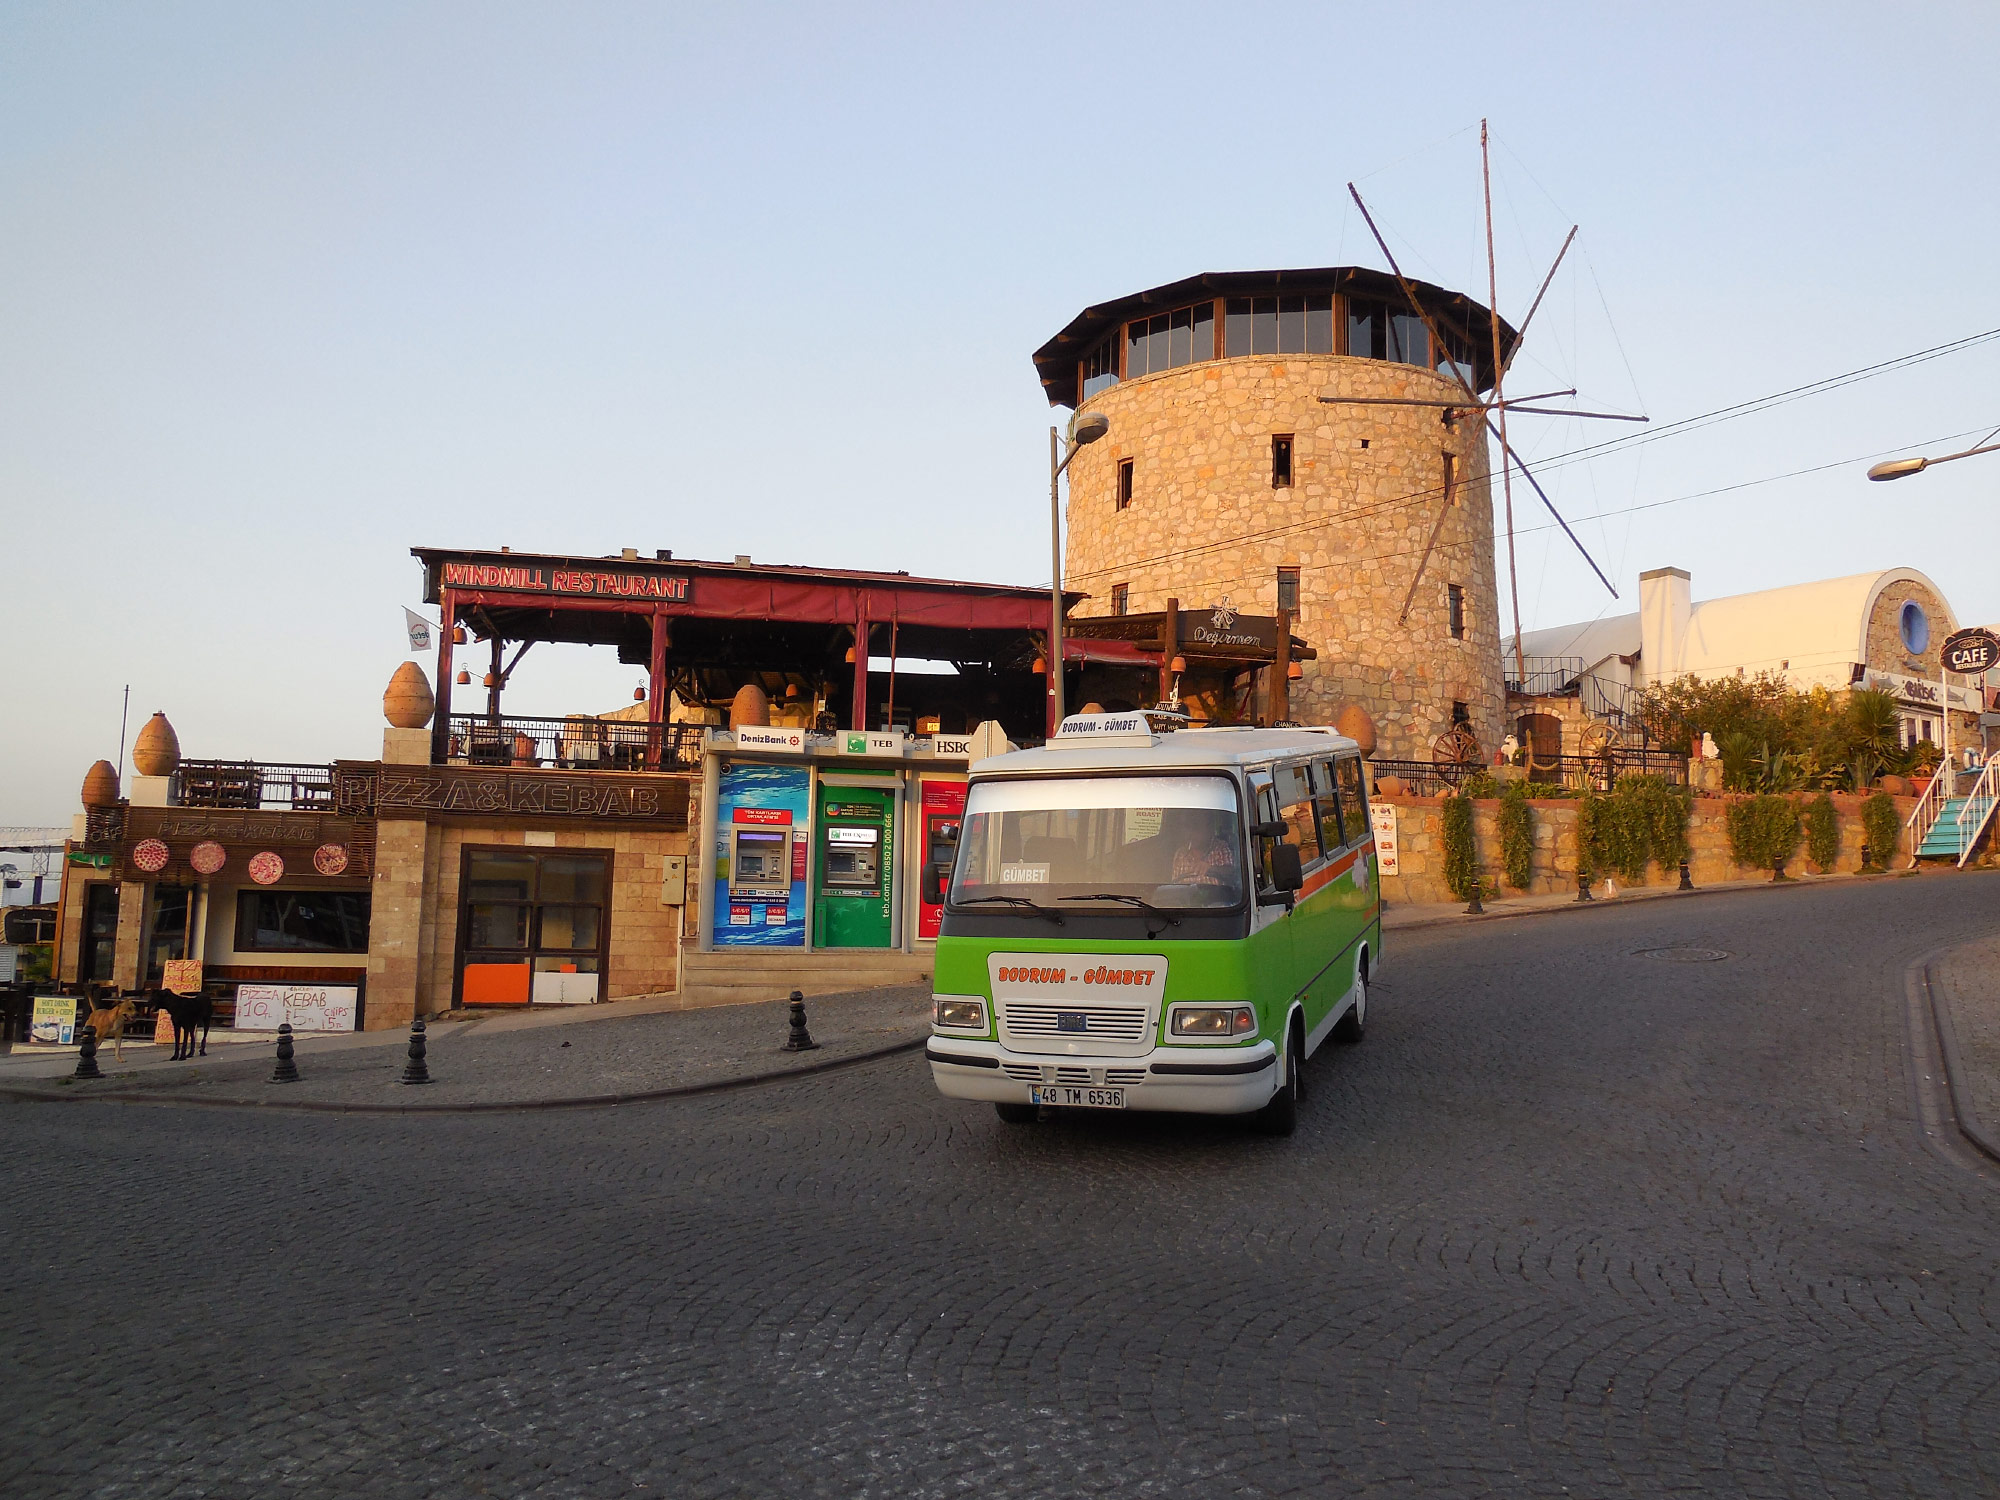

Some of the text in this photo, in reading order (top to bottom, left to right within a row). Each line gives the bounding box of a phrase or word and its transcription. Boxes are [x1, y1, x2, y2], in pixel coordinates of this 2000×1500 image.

[446, 563, 689, 599] WINDMILL RESTAURANT
[1952, 647, 1988, 665] CAFE
[1062, 721, 1096, 734] BODRUM
[1104, 718, 1138, 731] GÜMBET
[740, 733, 787, 745] DenizBank
[872, 740, 893, 748] TEB
[884, 813, 892, 828] 666
[884, 828, 892, 844] 000
[1003, 867, 1046, 882] GÜMBET
[998, 966, 1066, 984] BODRUM
[1083, 966, 1155, 985] GÜMBET
[282, 991, 327, 1008] KEBAB
[244, 1000, 268, 1017] 10
[293, 1008, 307, 1026] 5
[1042, 1088, 1057, 1103] 48
[1065, 1089, 1081, 1104] TM
[1088, 1090, 1121, 1106] 6536
